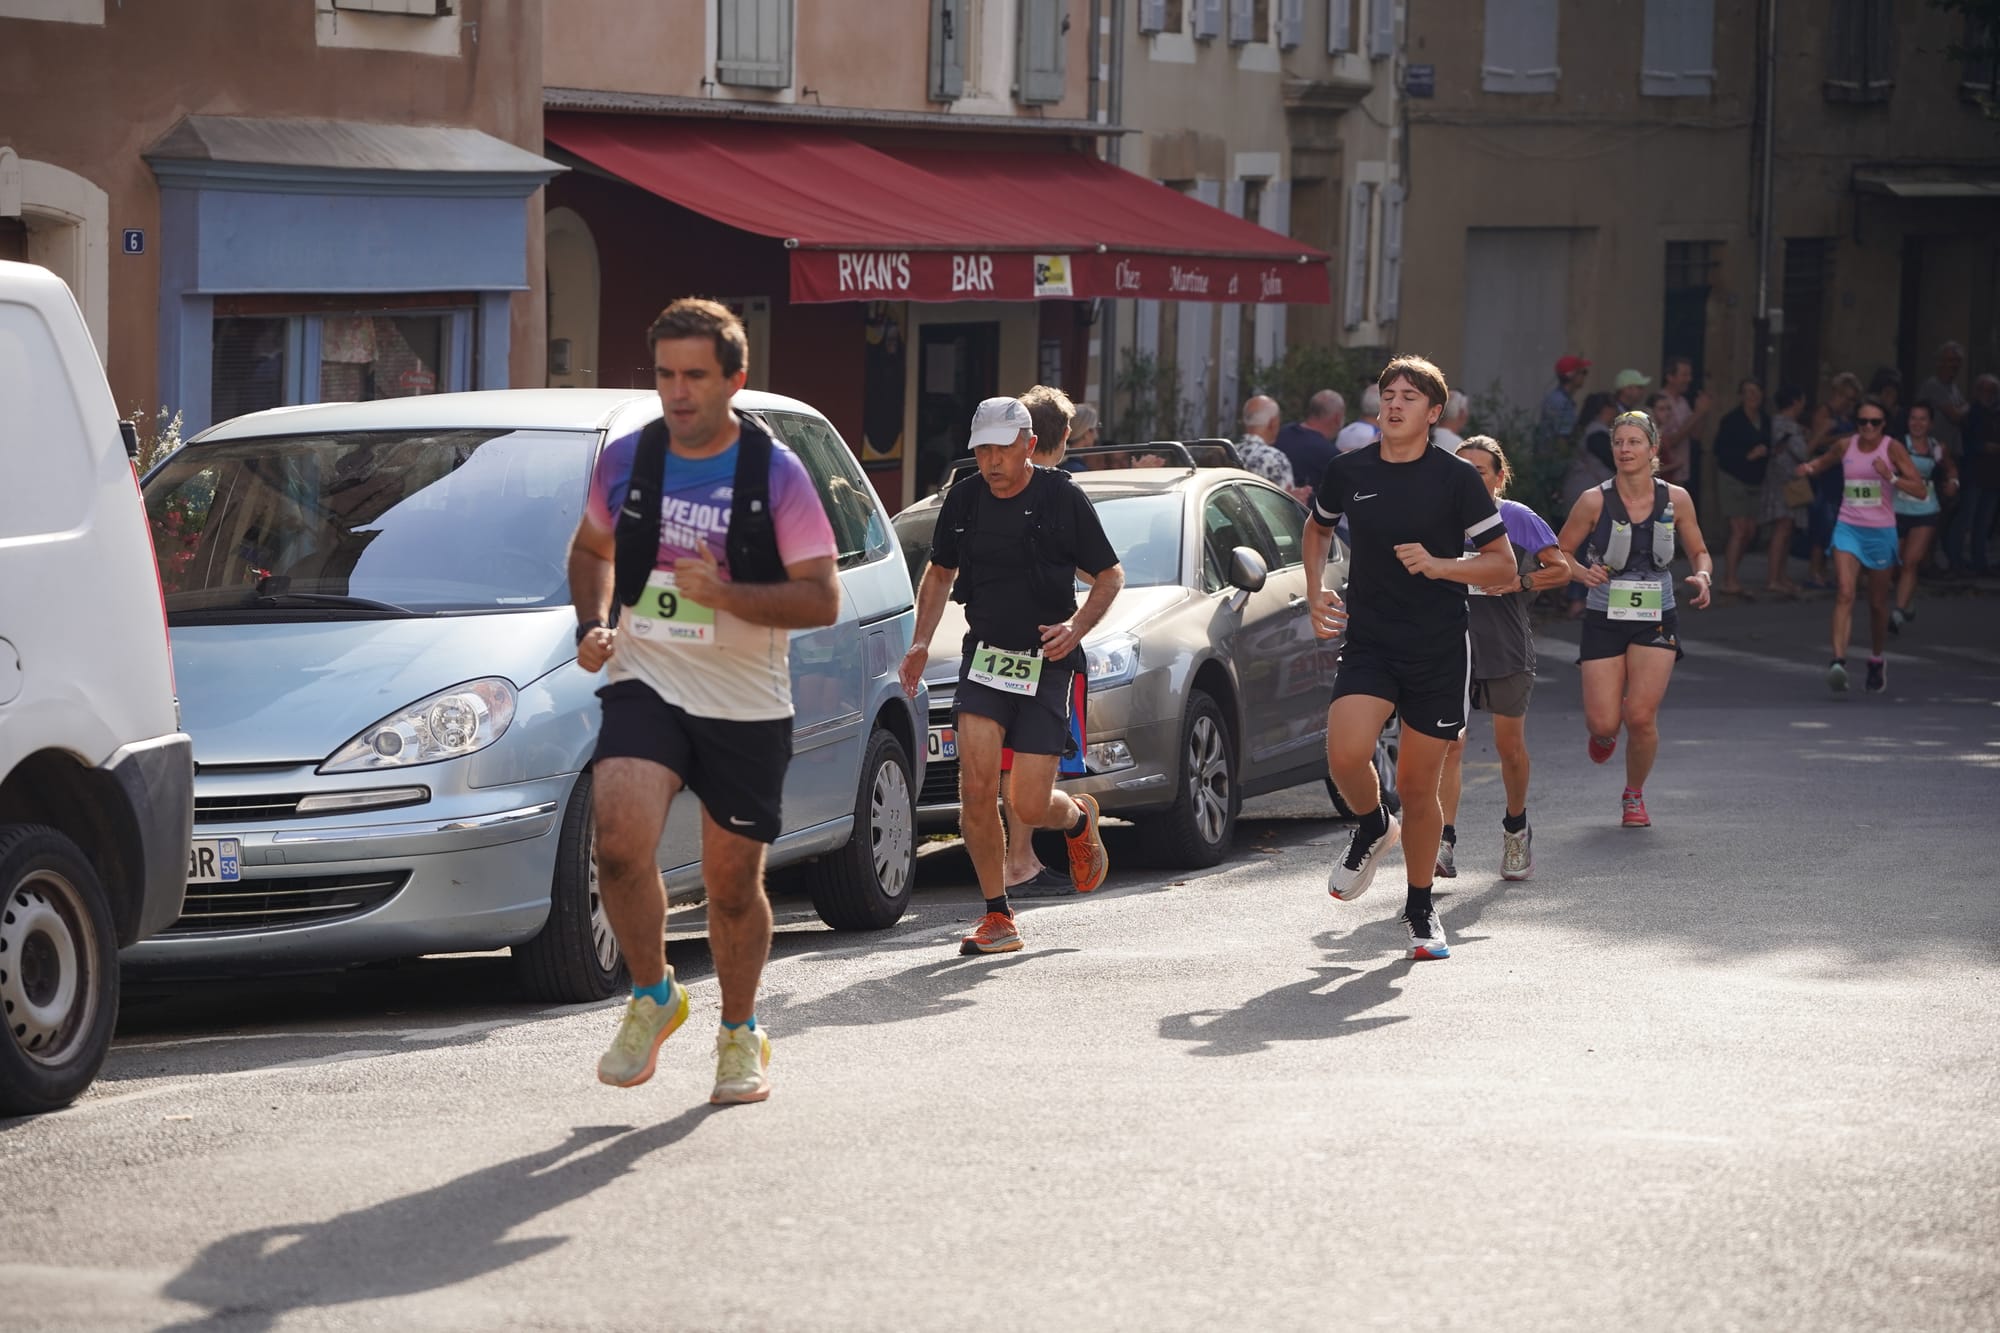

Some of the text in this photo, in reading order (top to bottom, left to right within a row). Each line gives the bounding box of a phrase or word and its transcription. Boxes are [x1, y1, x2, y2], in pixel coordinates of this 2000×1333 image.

[130, 232, 138, 250] 6
[838, 252, 993, 291] RYAN'S BAR
[1115, 259, 1141, 290] Chez
[1169, 265, 1208, 293] Martine
[1259, 267, 1282, 301] John
[1853, 487, 1871, 498] 18
[657, 591, 678, 618] 9
[1630, 591, 1642, 608] 5
[984, 654, 1031, 680] 125
[943, 744, 955, 755] 48
[221, 860, 237, 875] 59
